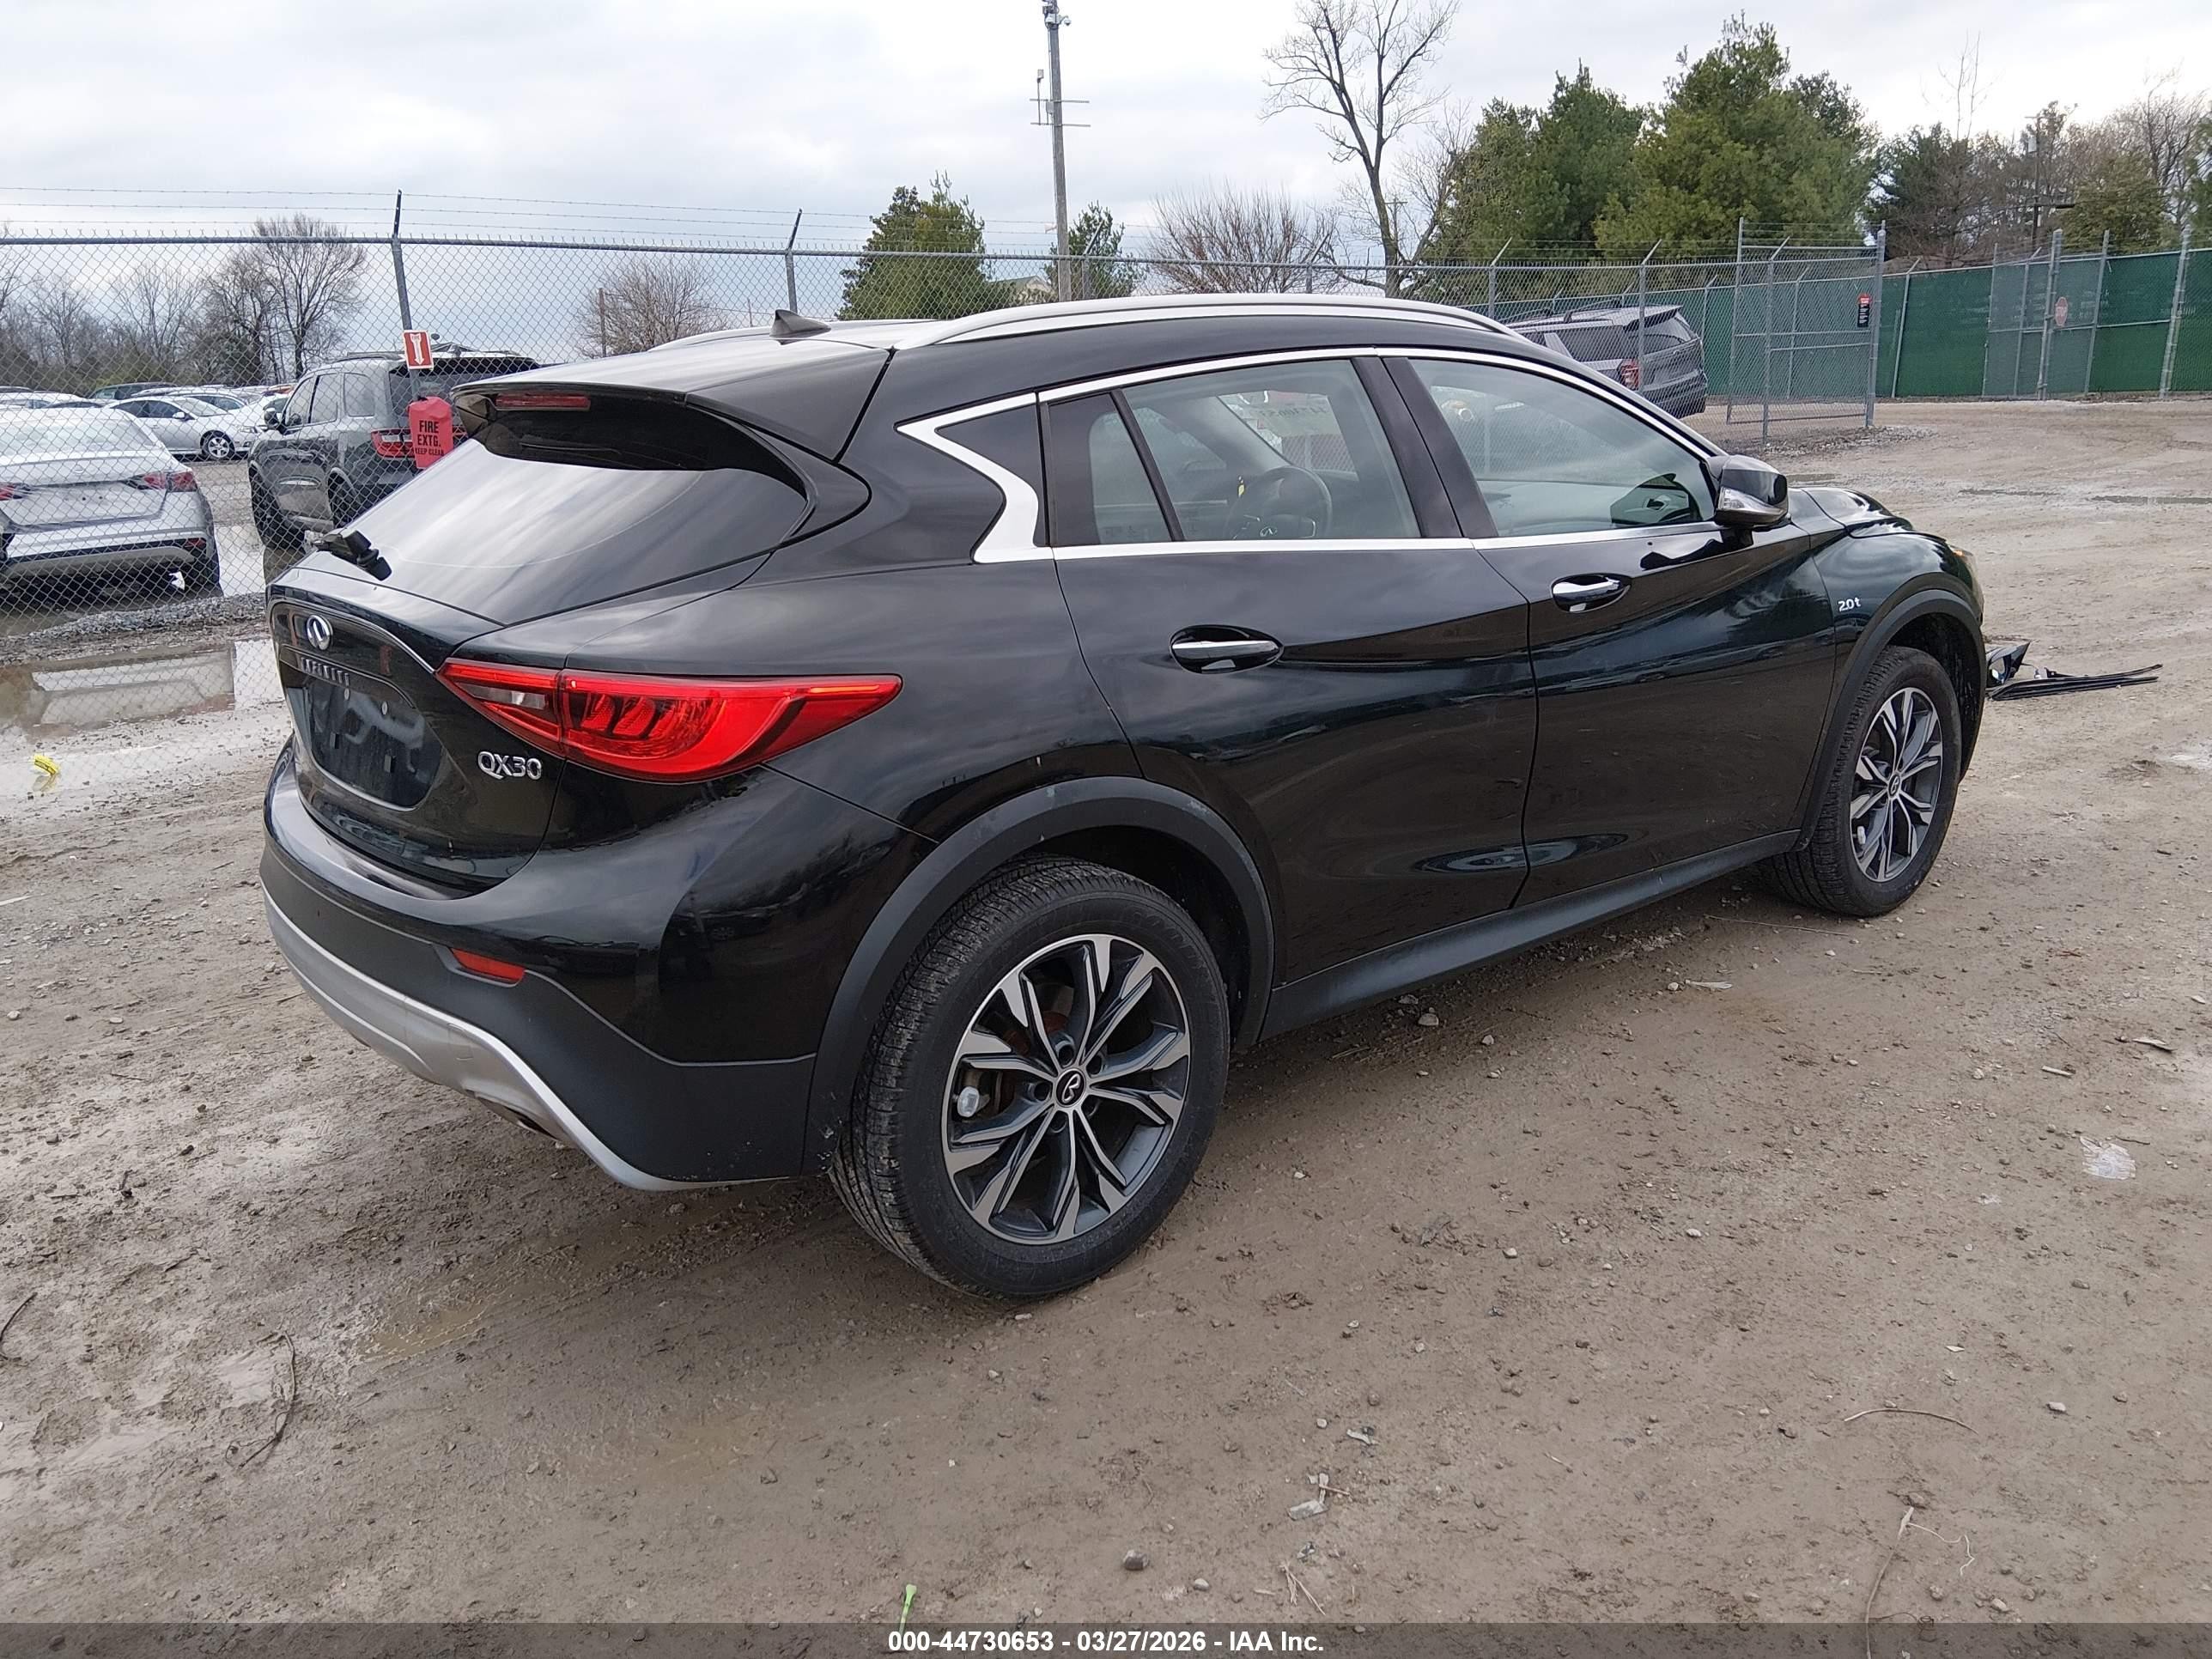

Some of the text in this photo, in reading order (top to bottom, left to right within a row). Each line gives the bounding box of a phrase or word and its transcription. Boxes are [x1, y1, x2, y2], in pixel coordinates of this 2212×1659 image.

[419, 420, 439, 433] FIRE
[417, 434, 441, 447] EXTG.
[477, 750, 542, 781] QX30
